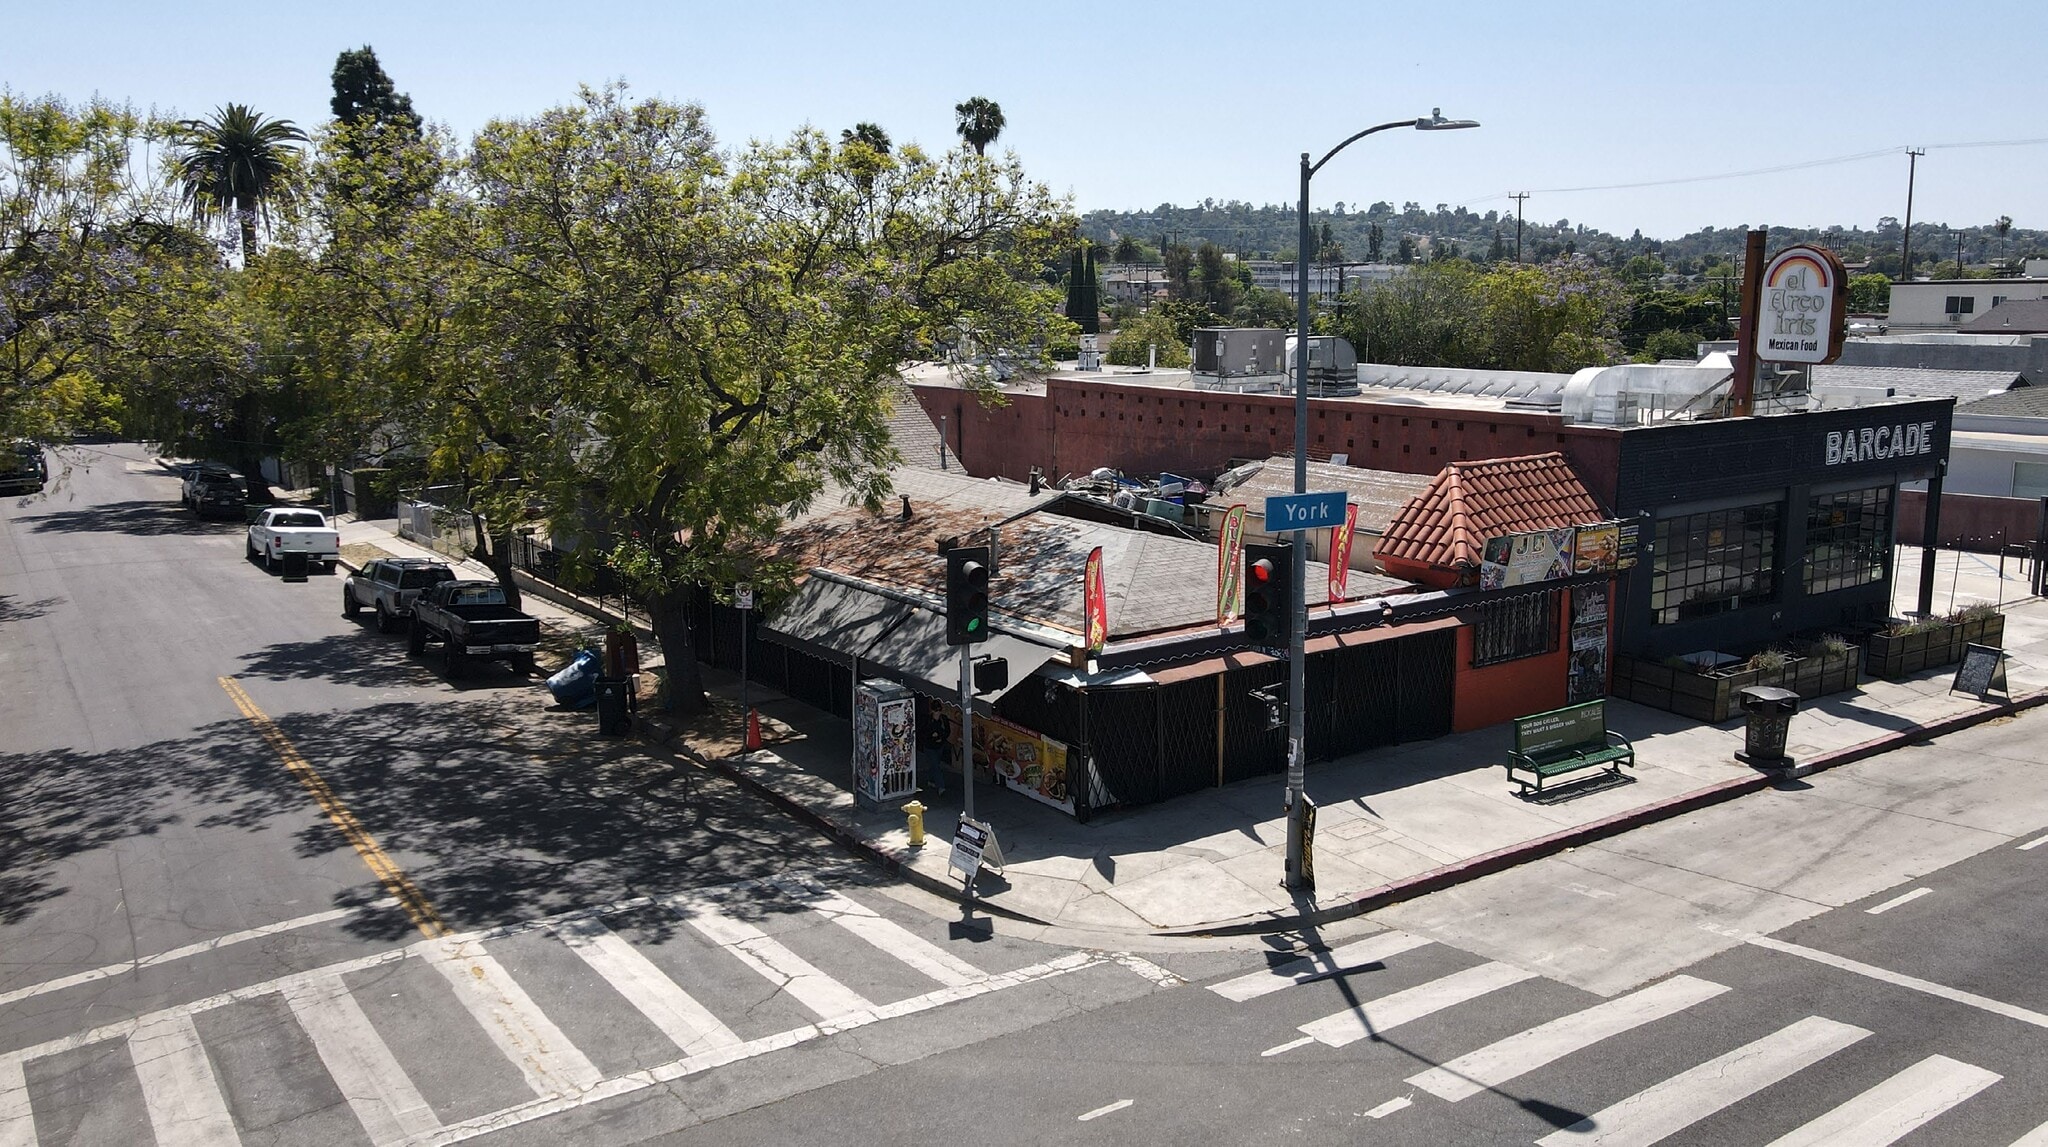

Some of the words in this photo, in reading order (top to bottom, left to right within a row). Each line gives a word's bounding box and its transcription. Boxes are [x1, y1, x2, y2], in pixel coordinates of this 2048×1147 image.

[1768, 338, 1799, 351] Mexican
[1800, 340, 1818, 352] Food
[1826, 422, 1933, 466] BARCADE
[1285, 502, 1329, 521] York
